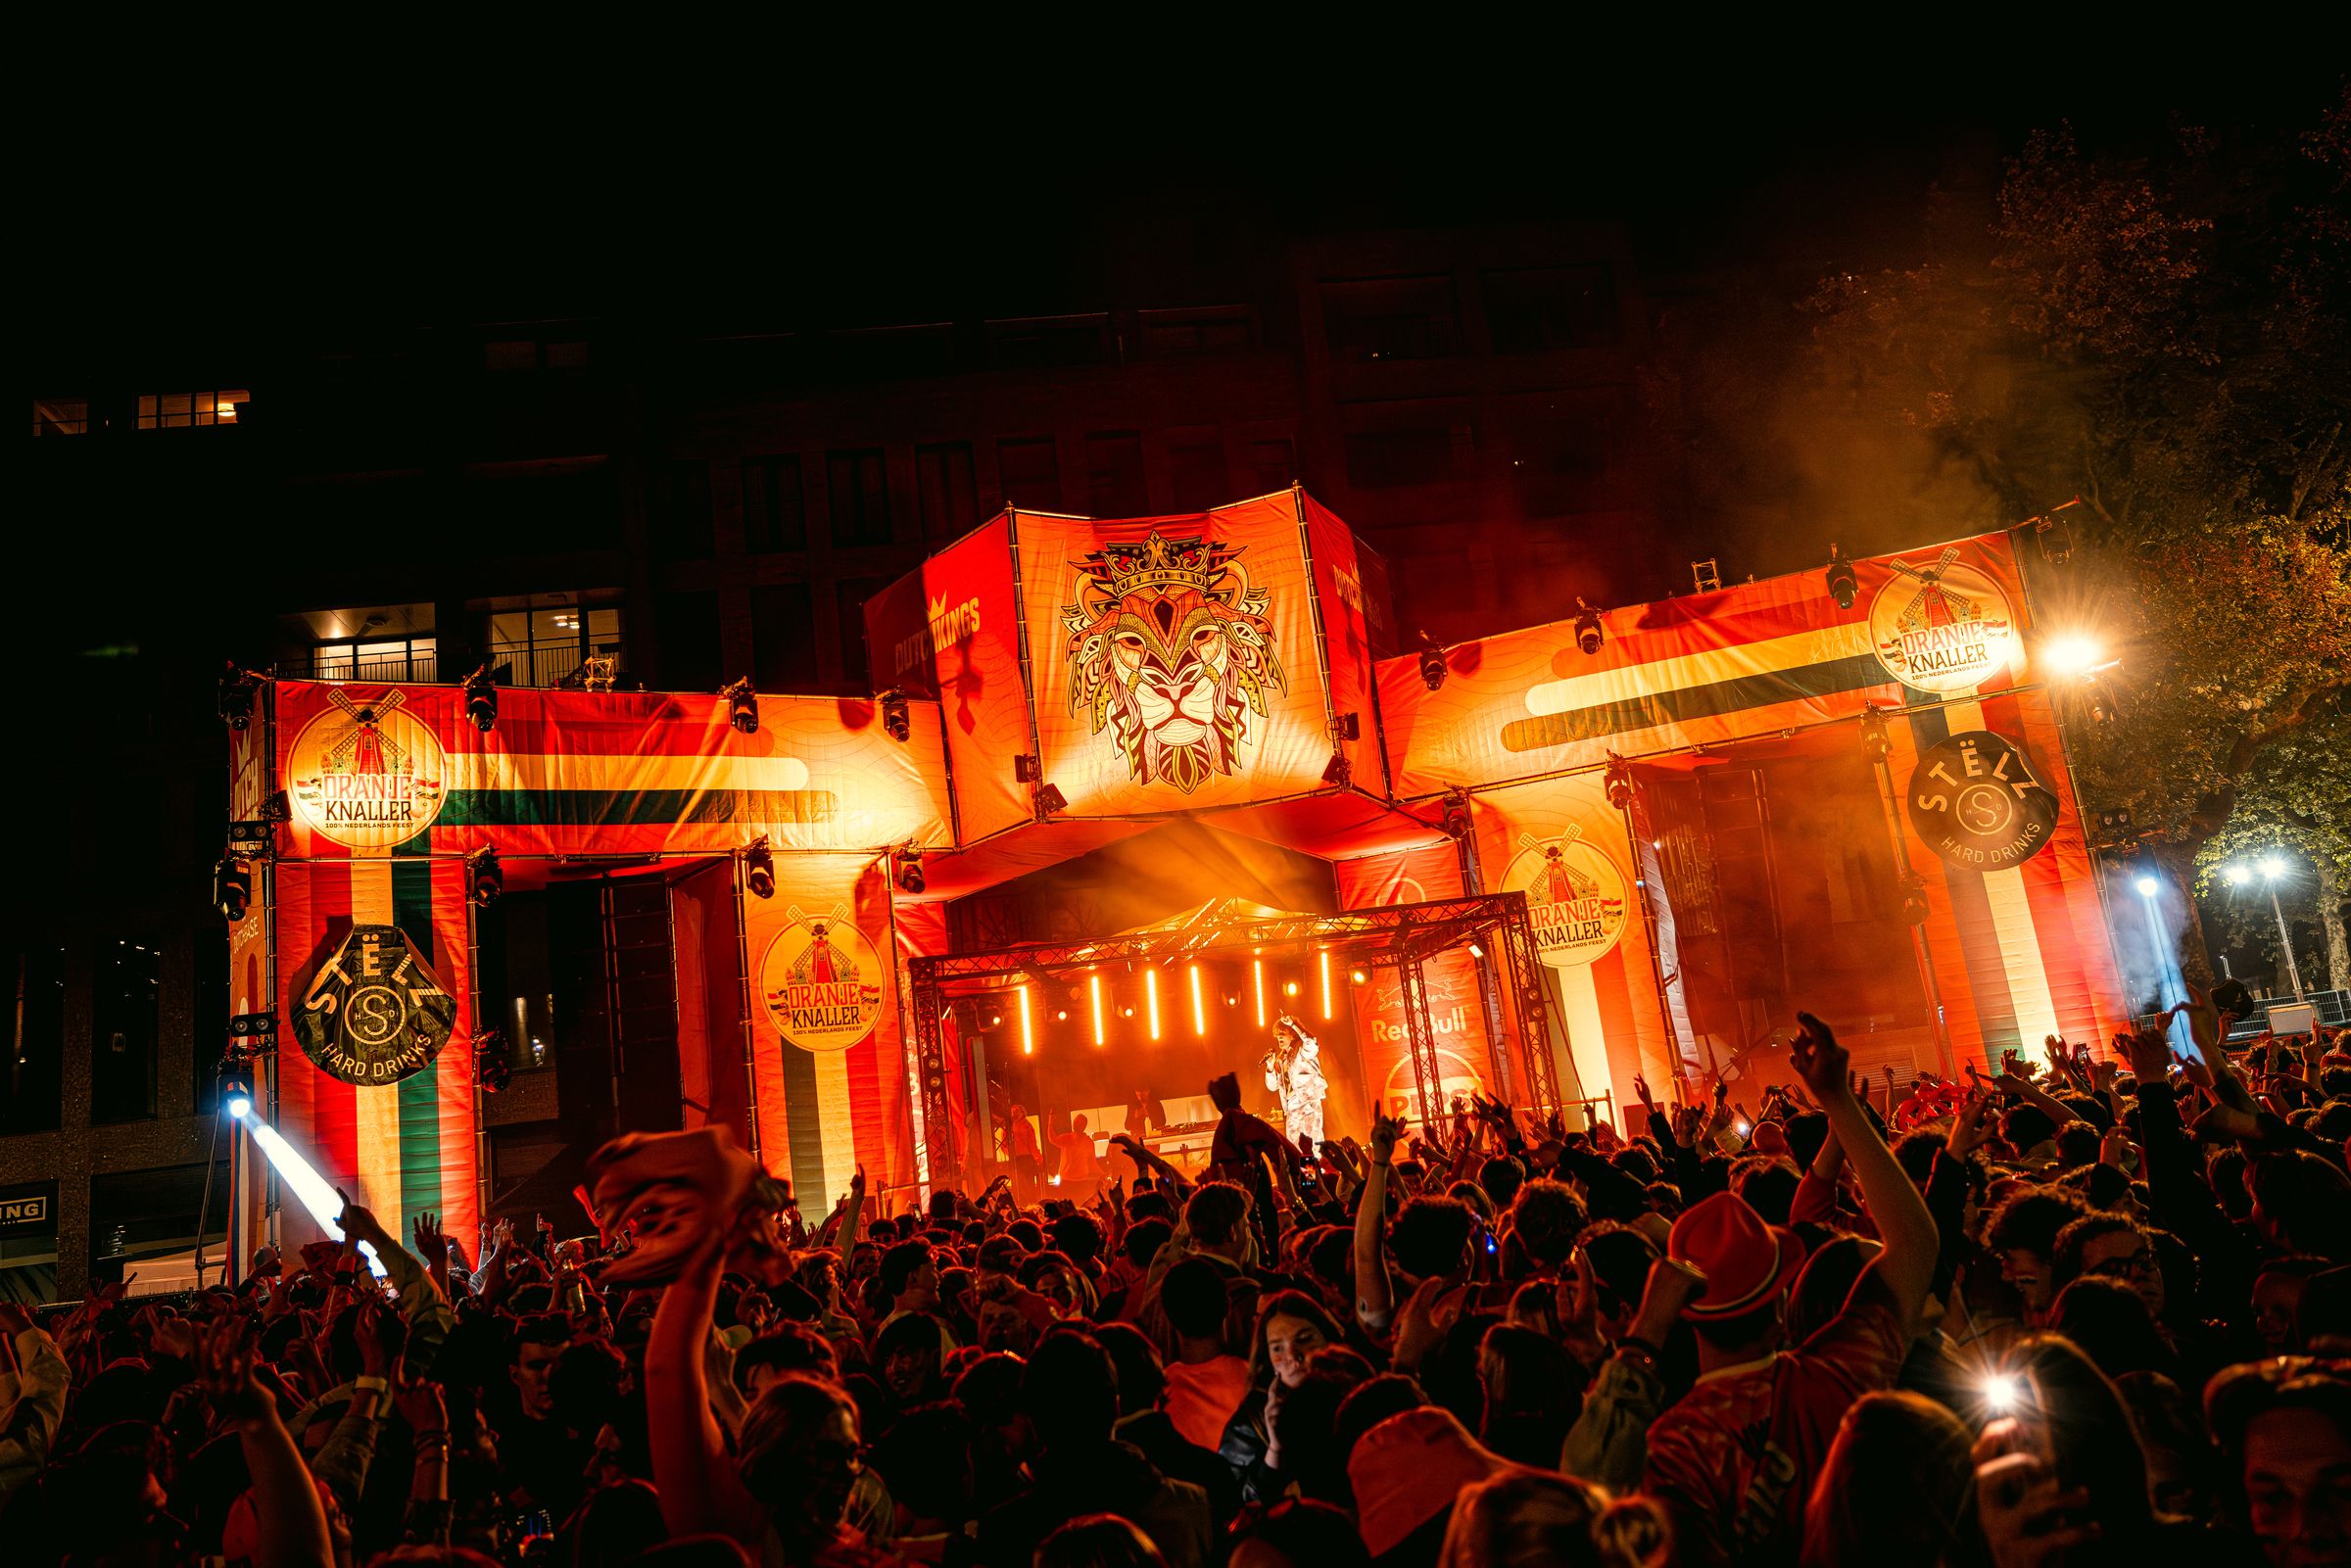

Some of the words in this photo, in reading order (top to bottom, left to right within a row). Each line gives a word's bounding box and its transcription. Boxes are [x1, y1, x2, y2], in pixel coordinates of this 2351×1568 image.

[1902, 620, 1981, 655] ORANJE
[1907, 643, 1989, 675] KNALLER
[1929, 666, 1971, 679] NEDERLANDS
[323, 774, 412, 800] ORANJE
[325, 800, 412, 821] KNALLER
[1941, 836, 1984, 863] HARD
[1991, 822, 2040, 863] DRINKS
[1528, 898, 1601, 929] ORANJE
[1532, 920, 1604, 948] KNALLER
[1550, 942, 1588, 952] NEDERLANDS
[789, 982, 859, 1009] ORANJE
[792, 1006, 861, 1029] KNALLER
[321, 1042, 366, 1077] HARD
[373, 1033, 432, 1077] DRINKS
